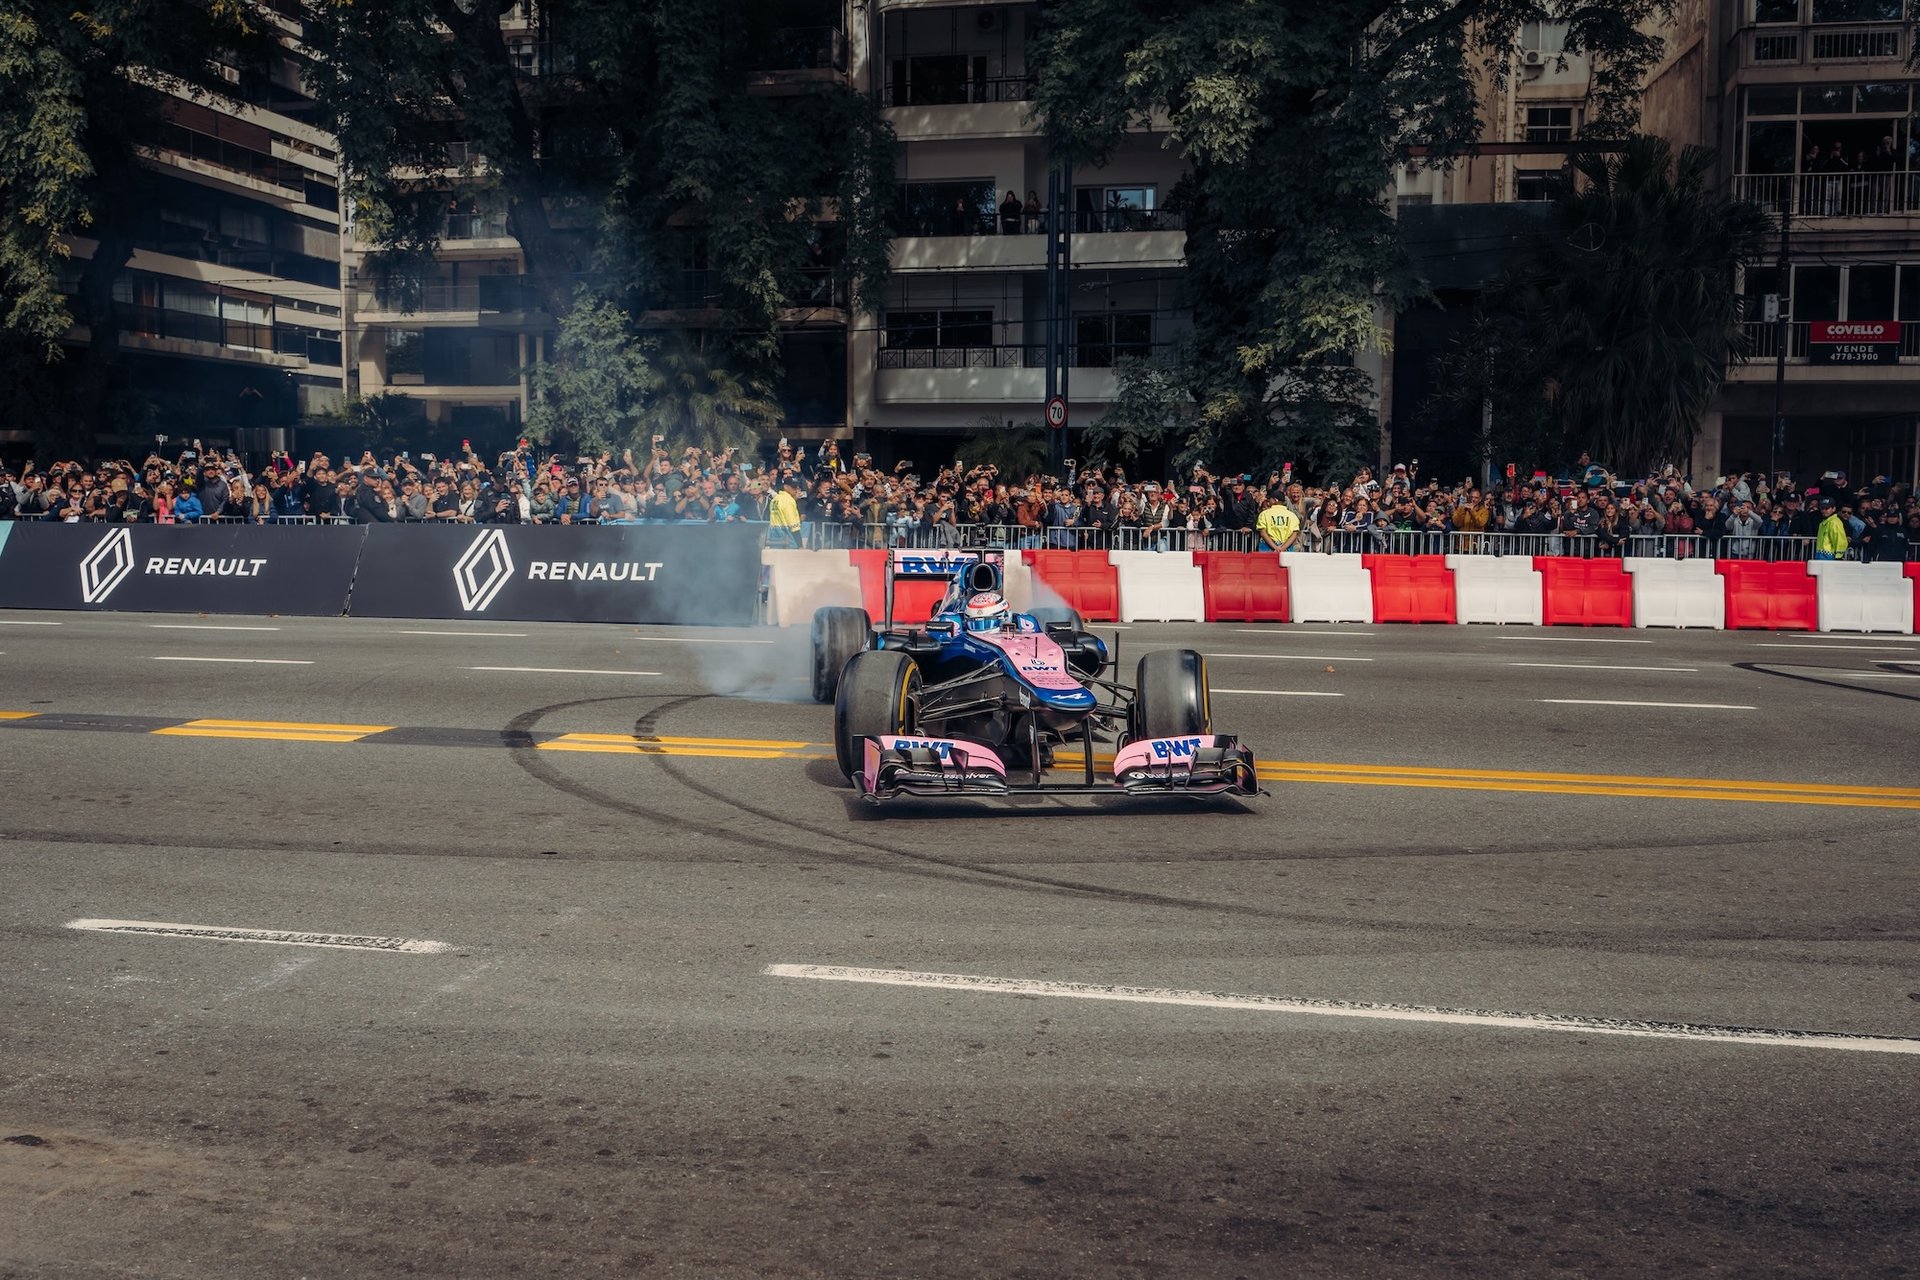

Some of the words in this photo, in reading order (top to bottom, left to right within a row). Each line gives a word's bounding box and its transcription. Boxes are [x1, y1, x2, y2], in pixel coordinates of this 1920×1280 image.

[1826, 325, 1884, 335] COVELLO
[1836, 345, 1874, 353] VENDE
[1830, 353, 1879, 361] 4778-3900
[1051, 406, 1063, 419] 70
[144, 557, 267, 576] RENAULT
[527, 561, 664, 581] RENAULT
